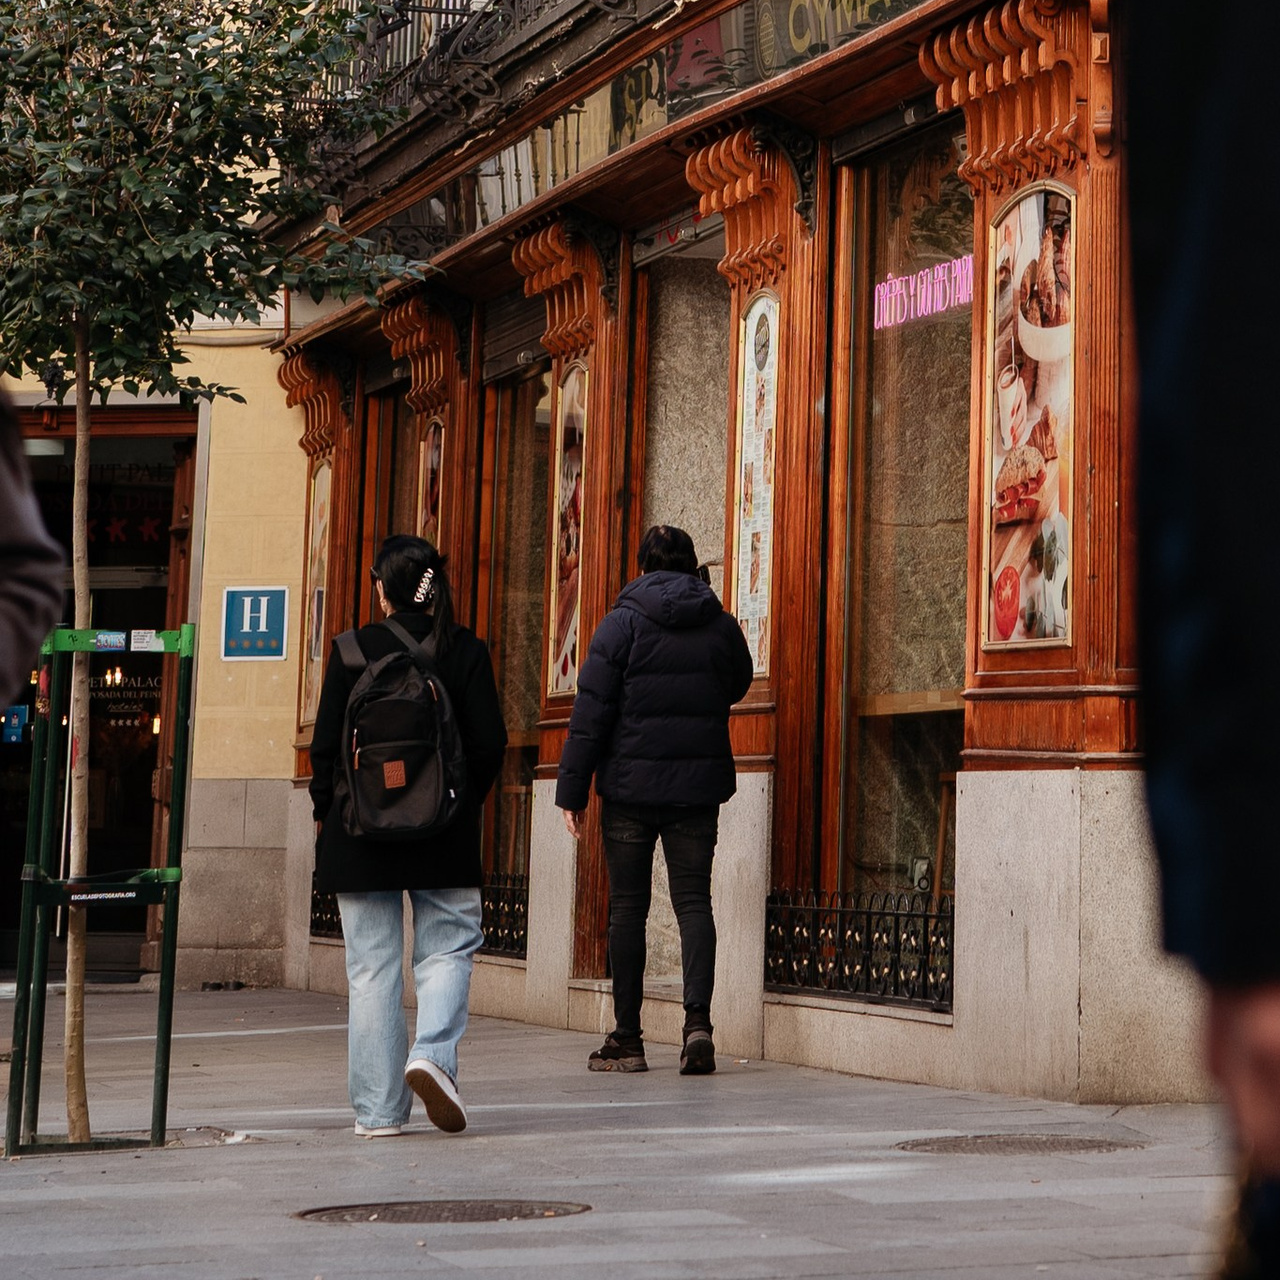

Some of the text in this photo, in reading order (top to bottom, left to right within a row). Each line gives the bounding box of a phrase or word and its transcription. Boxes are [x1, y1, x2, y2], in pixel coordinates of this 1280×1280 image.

[909, 273, 917, 320] Y
[240, 596, 270, 633] H
[121, 676, 163, 688] PALAC
